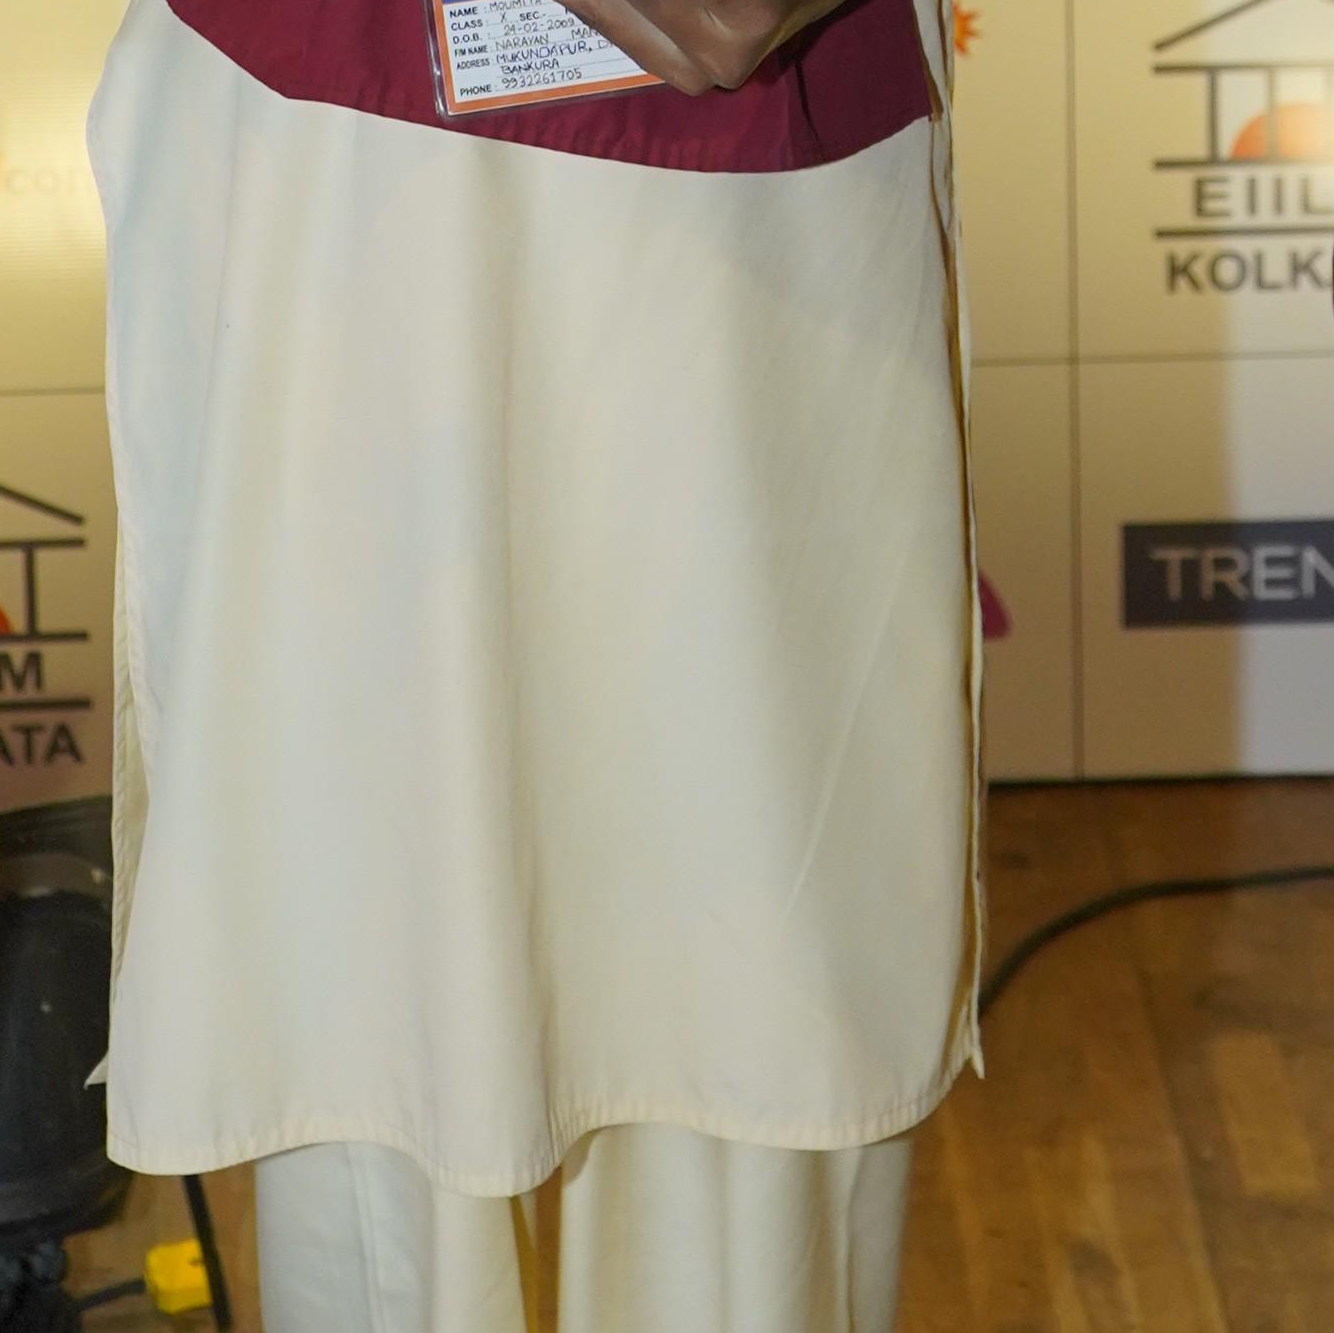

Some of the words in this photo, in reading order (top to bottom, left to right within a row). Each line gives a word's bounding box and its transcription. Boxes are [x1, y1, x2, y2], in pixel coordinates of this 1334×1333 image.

[449, 6, 478, 17] NAME
[451, 19, 483, 31] CLASS
[453, 35, 482, 44] D.O.B.
[495, 34, 549, 52] NARAYAN
[456, 58, 490, 70] ADDRESS
[501, 59, 560, 75] BANKURA
[460, 85, 492, 96] PHONE
